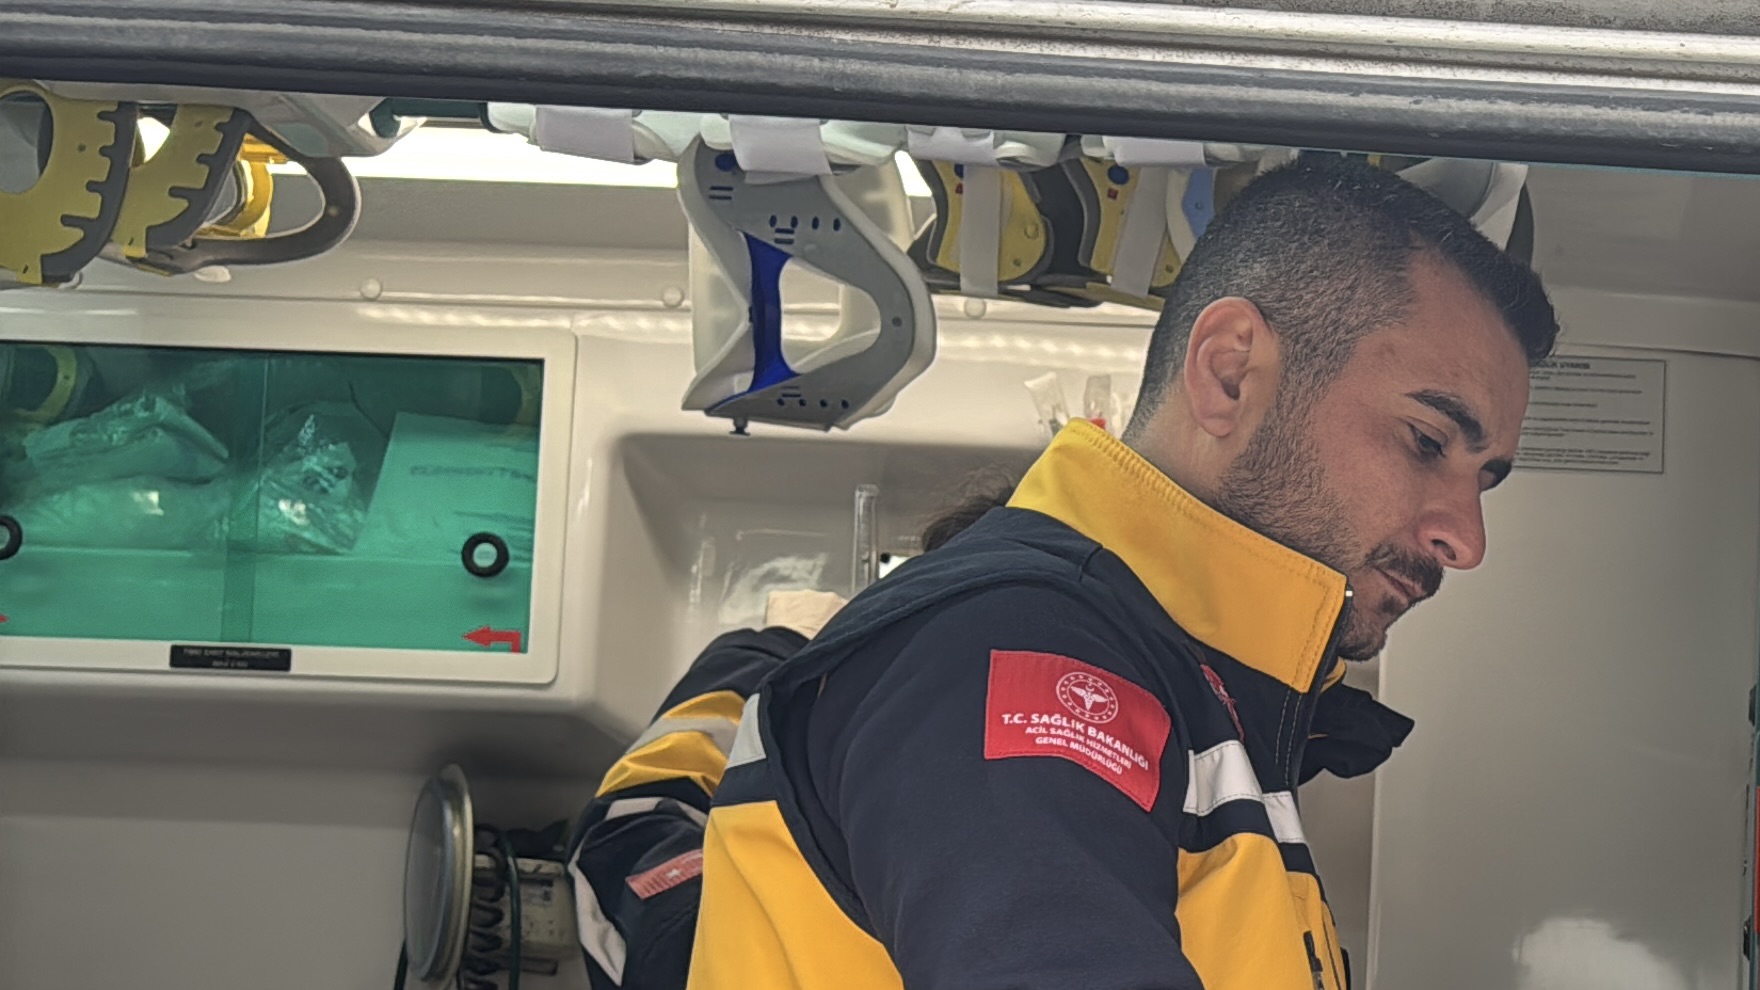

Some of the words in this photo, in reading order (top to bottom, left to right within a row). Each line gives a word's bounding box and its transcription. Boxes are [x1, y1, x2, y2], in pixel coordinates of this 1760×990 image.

[1025, 726, 1048, 734] ACİL
[1001, 713, 1027, 725] T.C.
[1087, 725, 1149, 771] BAKANLIĞI
[1035, 736, 1068, 747] GENEL
